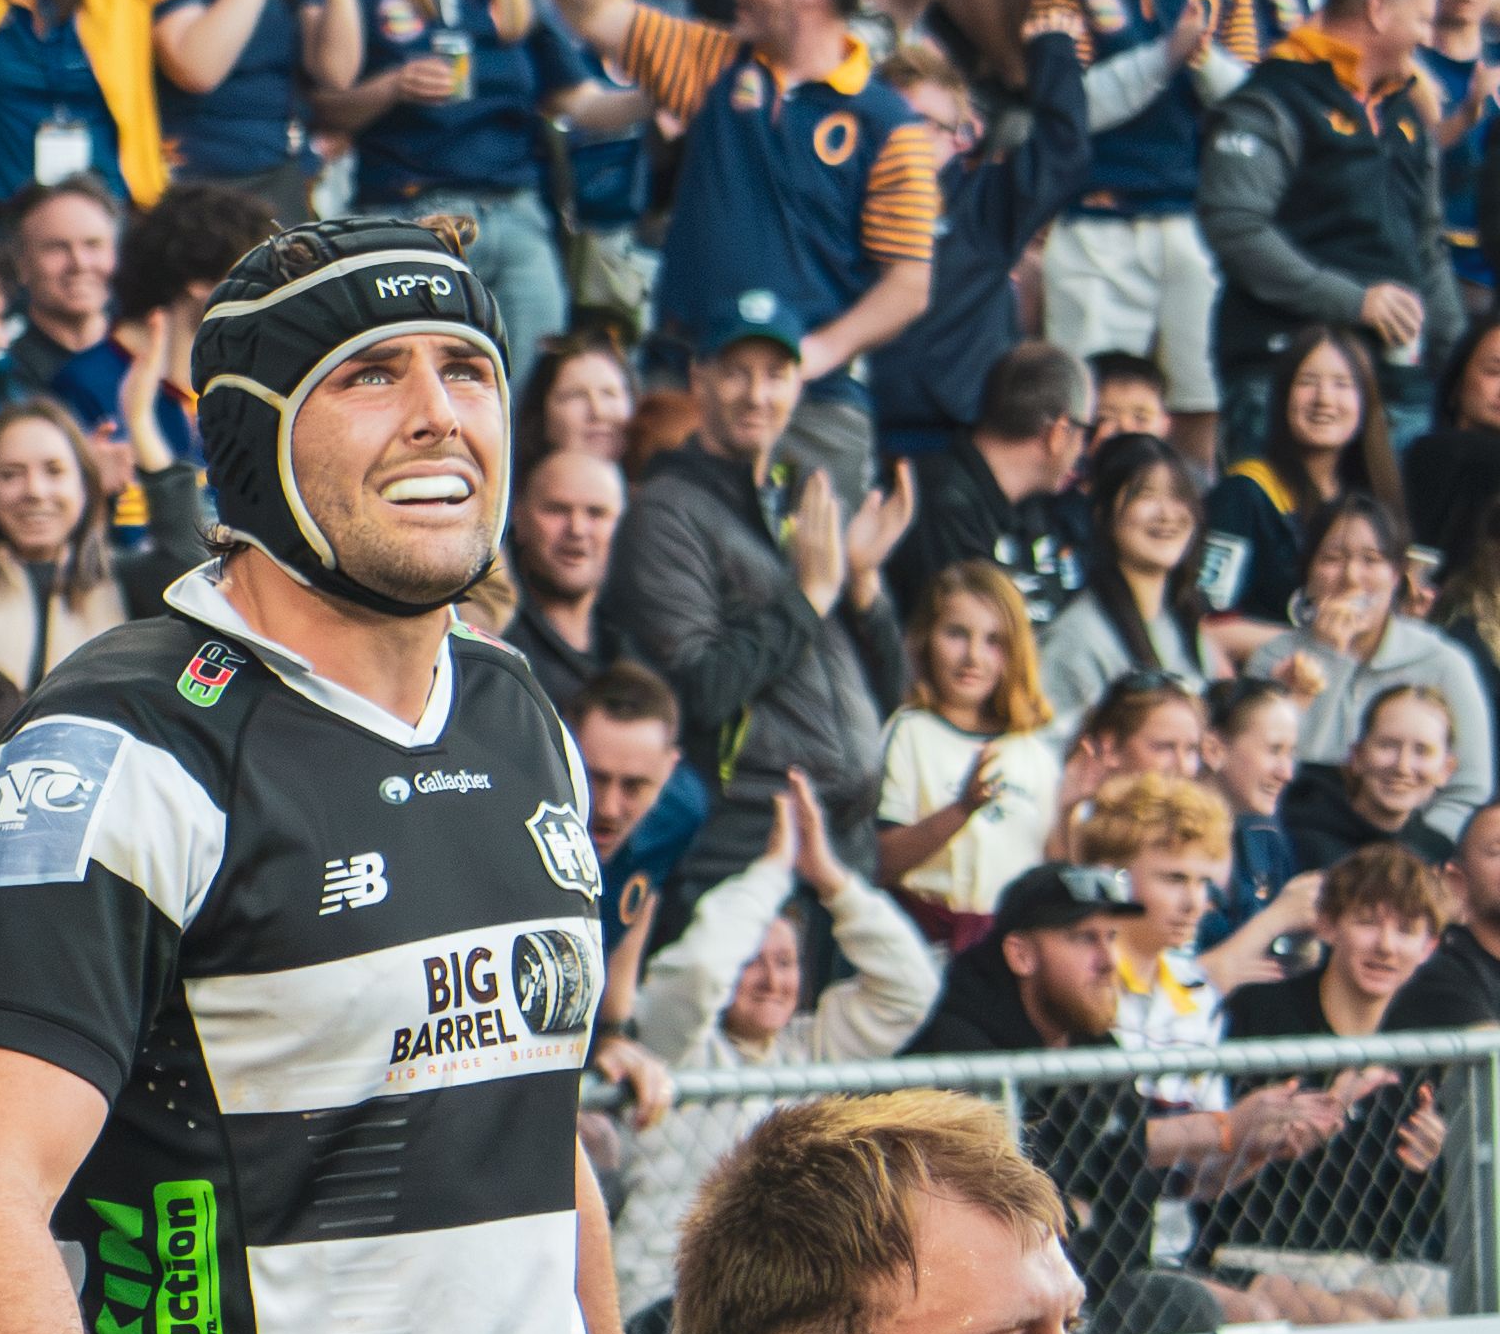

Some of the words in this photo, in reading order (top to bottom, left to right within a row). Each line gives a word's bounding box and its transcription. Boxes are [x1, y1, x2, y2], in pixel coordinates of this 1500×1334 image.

[413, 769, 492, 794] Gallagher
[423, 947, 499, 1015] BIG
[390, 1009, 518, 1065] BARREL
[427, 1056, 483, 1076] RANGE
